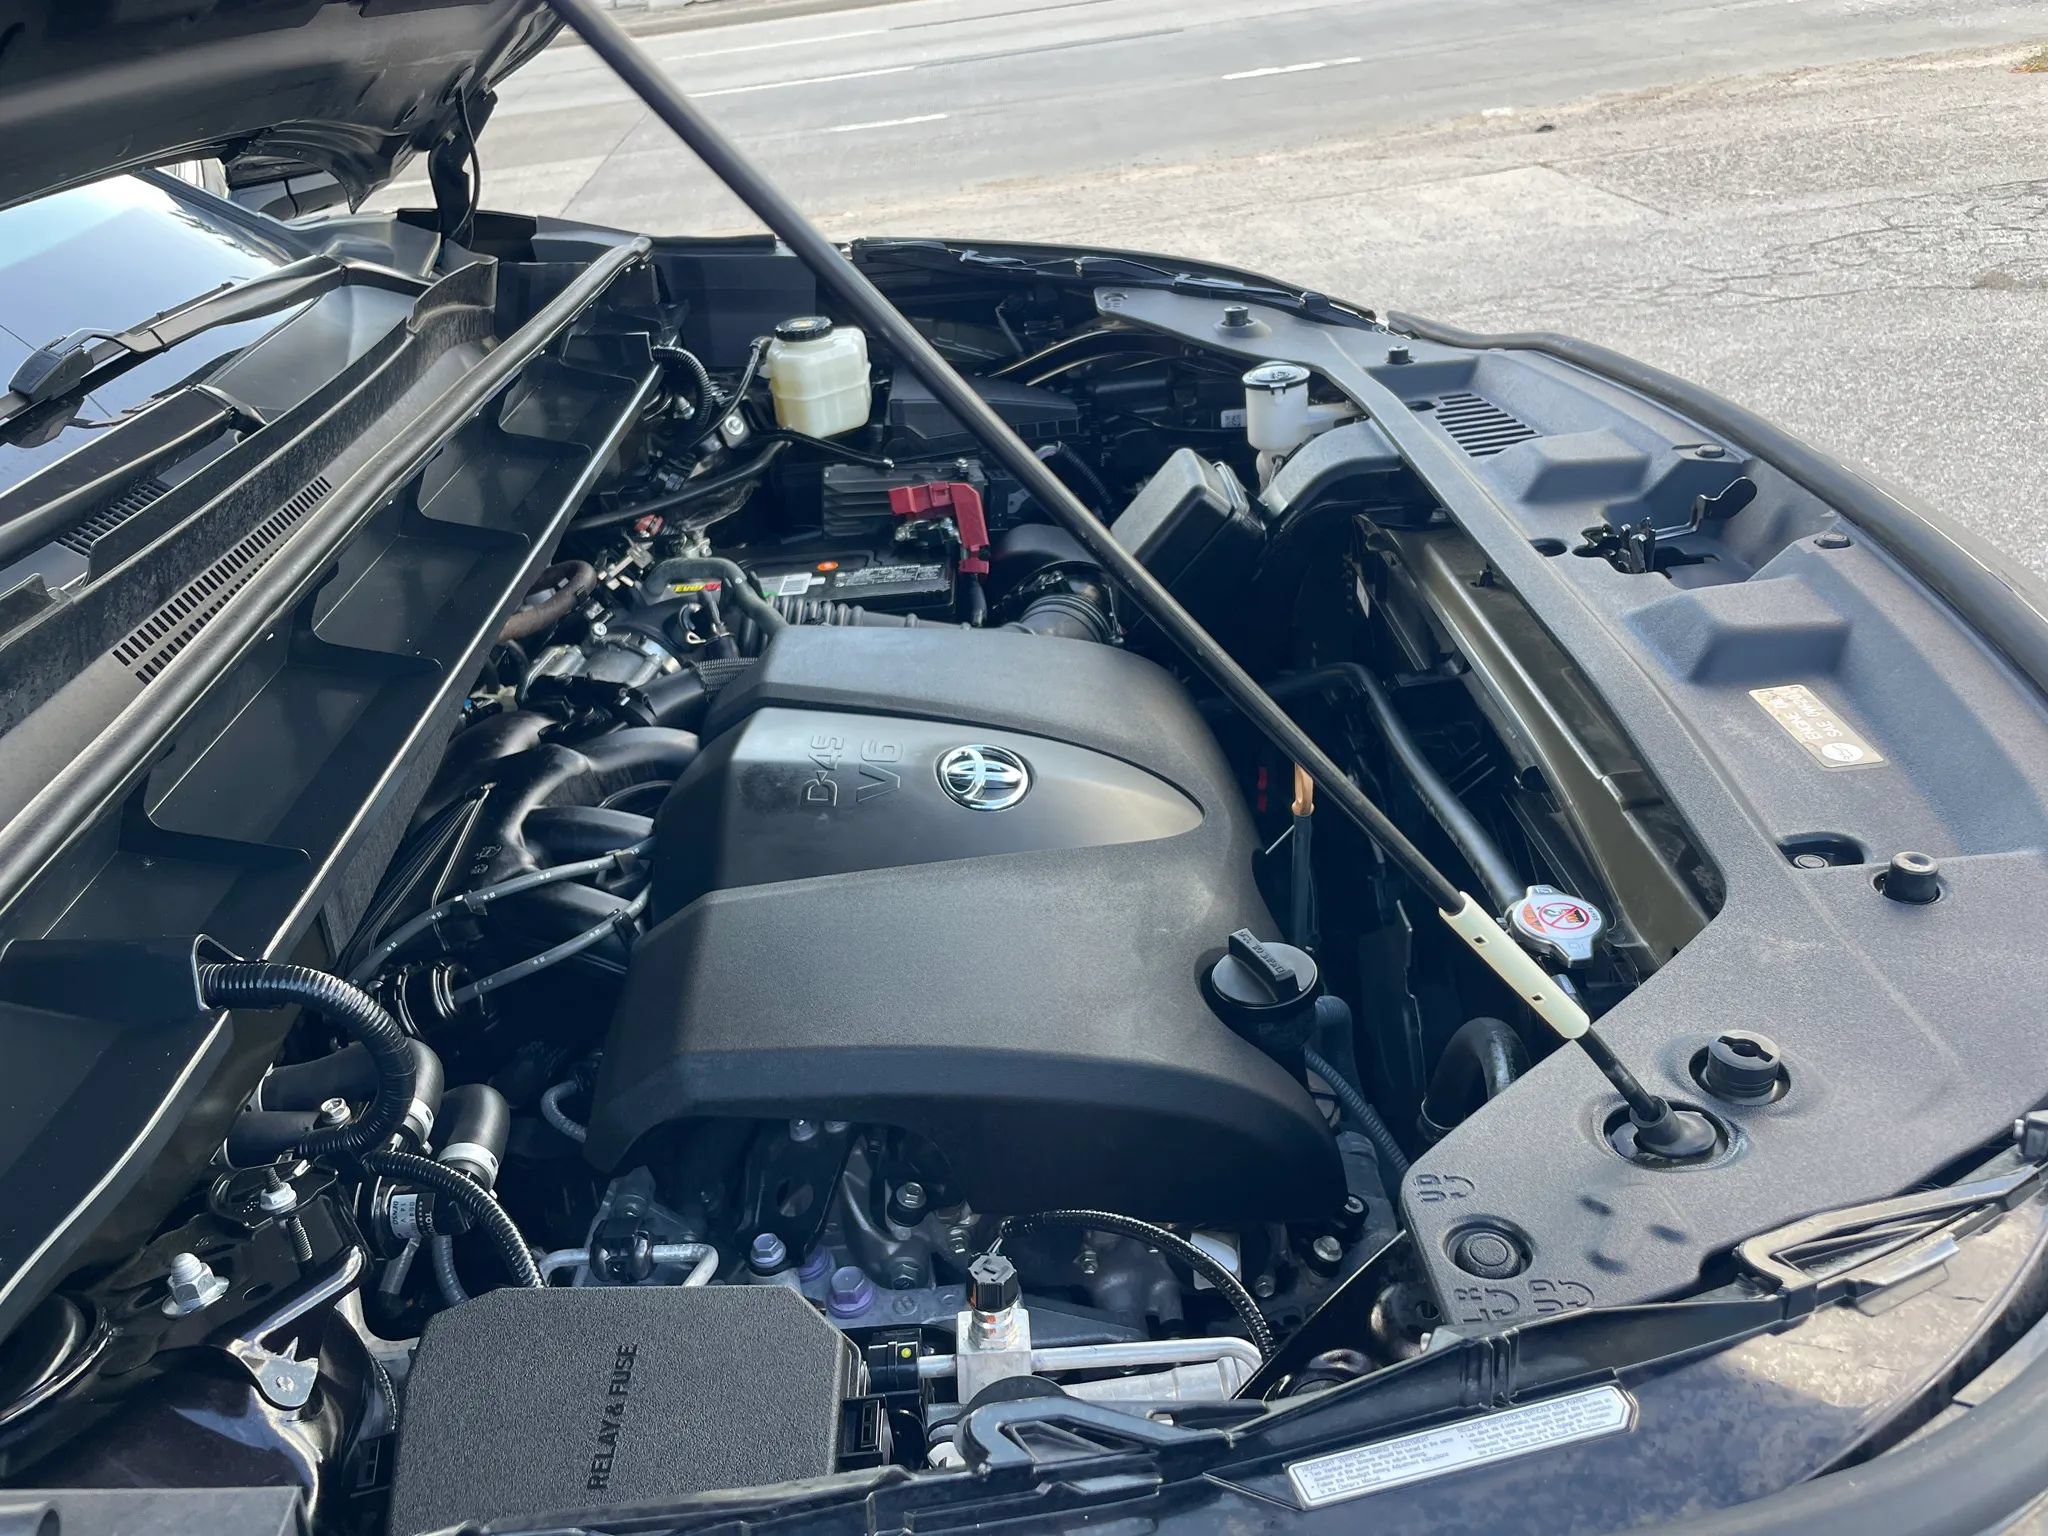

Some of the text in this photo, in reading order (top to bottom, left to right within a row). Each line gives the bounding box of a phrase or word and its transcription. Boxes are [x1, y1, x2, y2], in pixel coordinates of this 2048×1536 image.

[856, 738, 903, 803] V6
[587, 1343, 638, 1489] RELAY & FUSE
